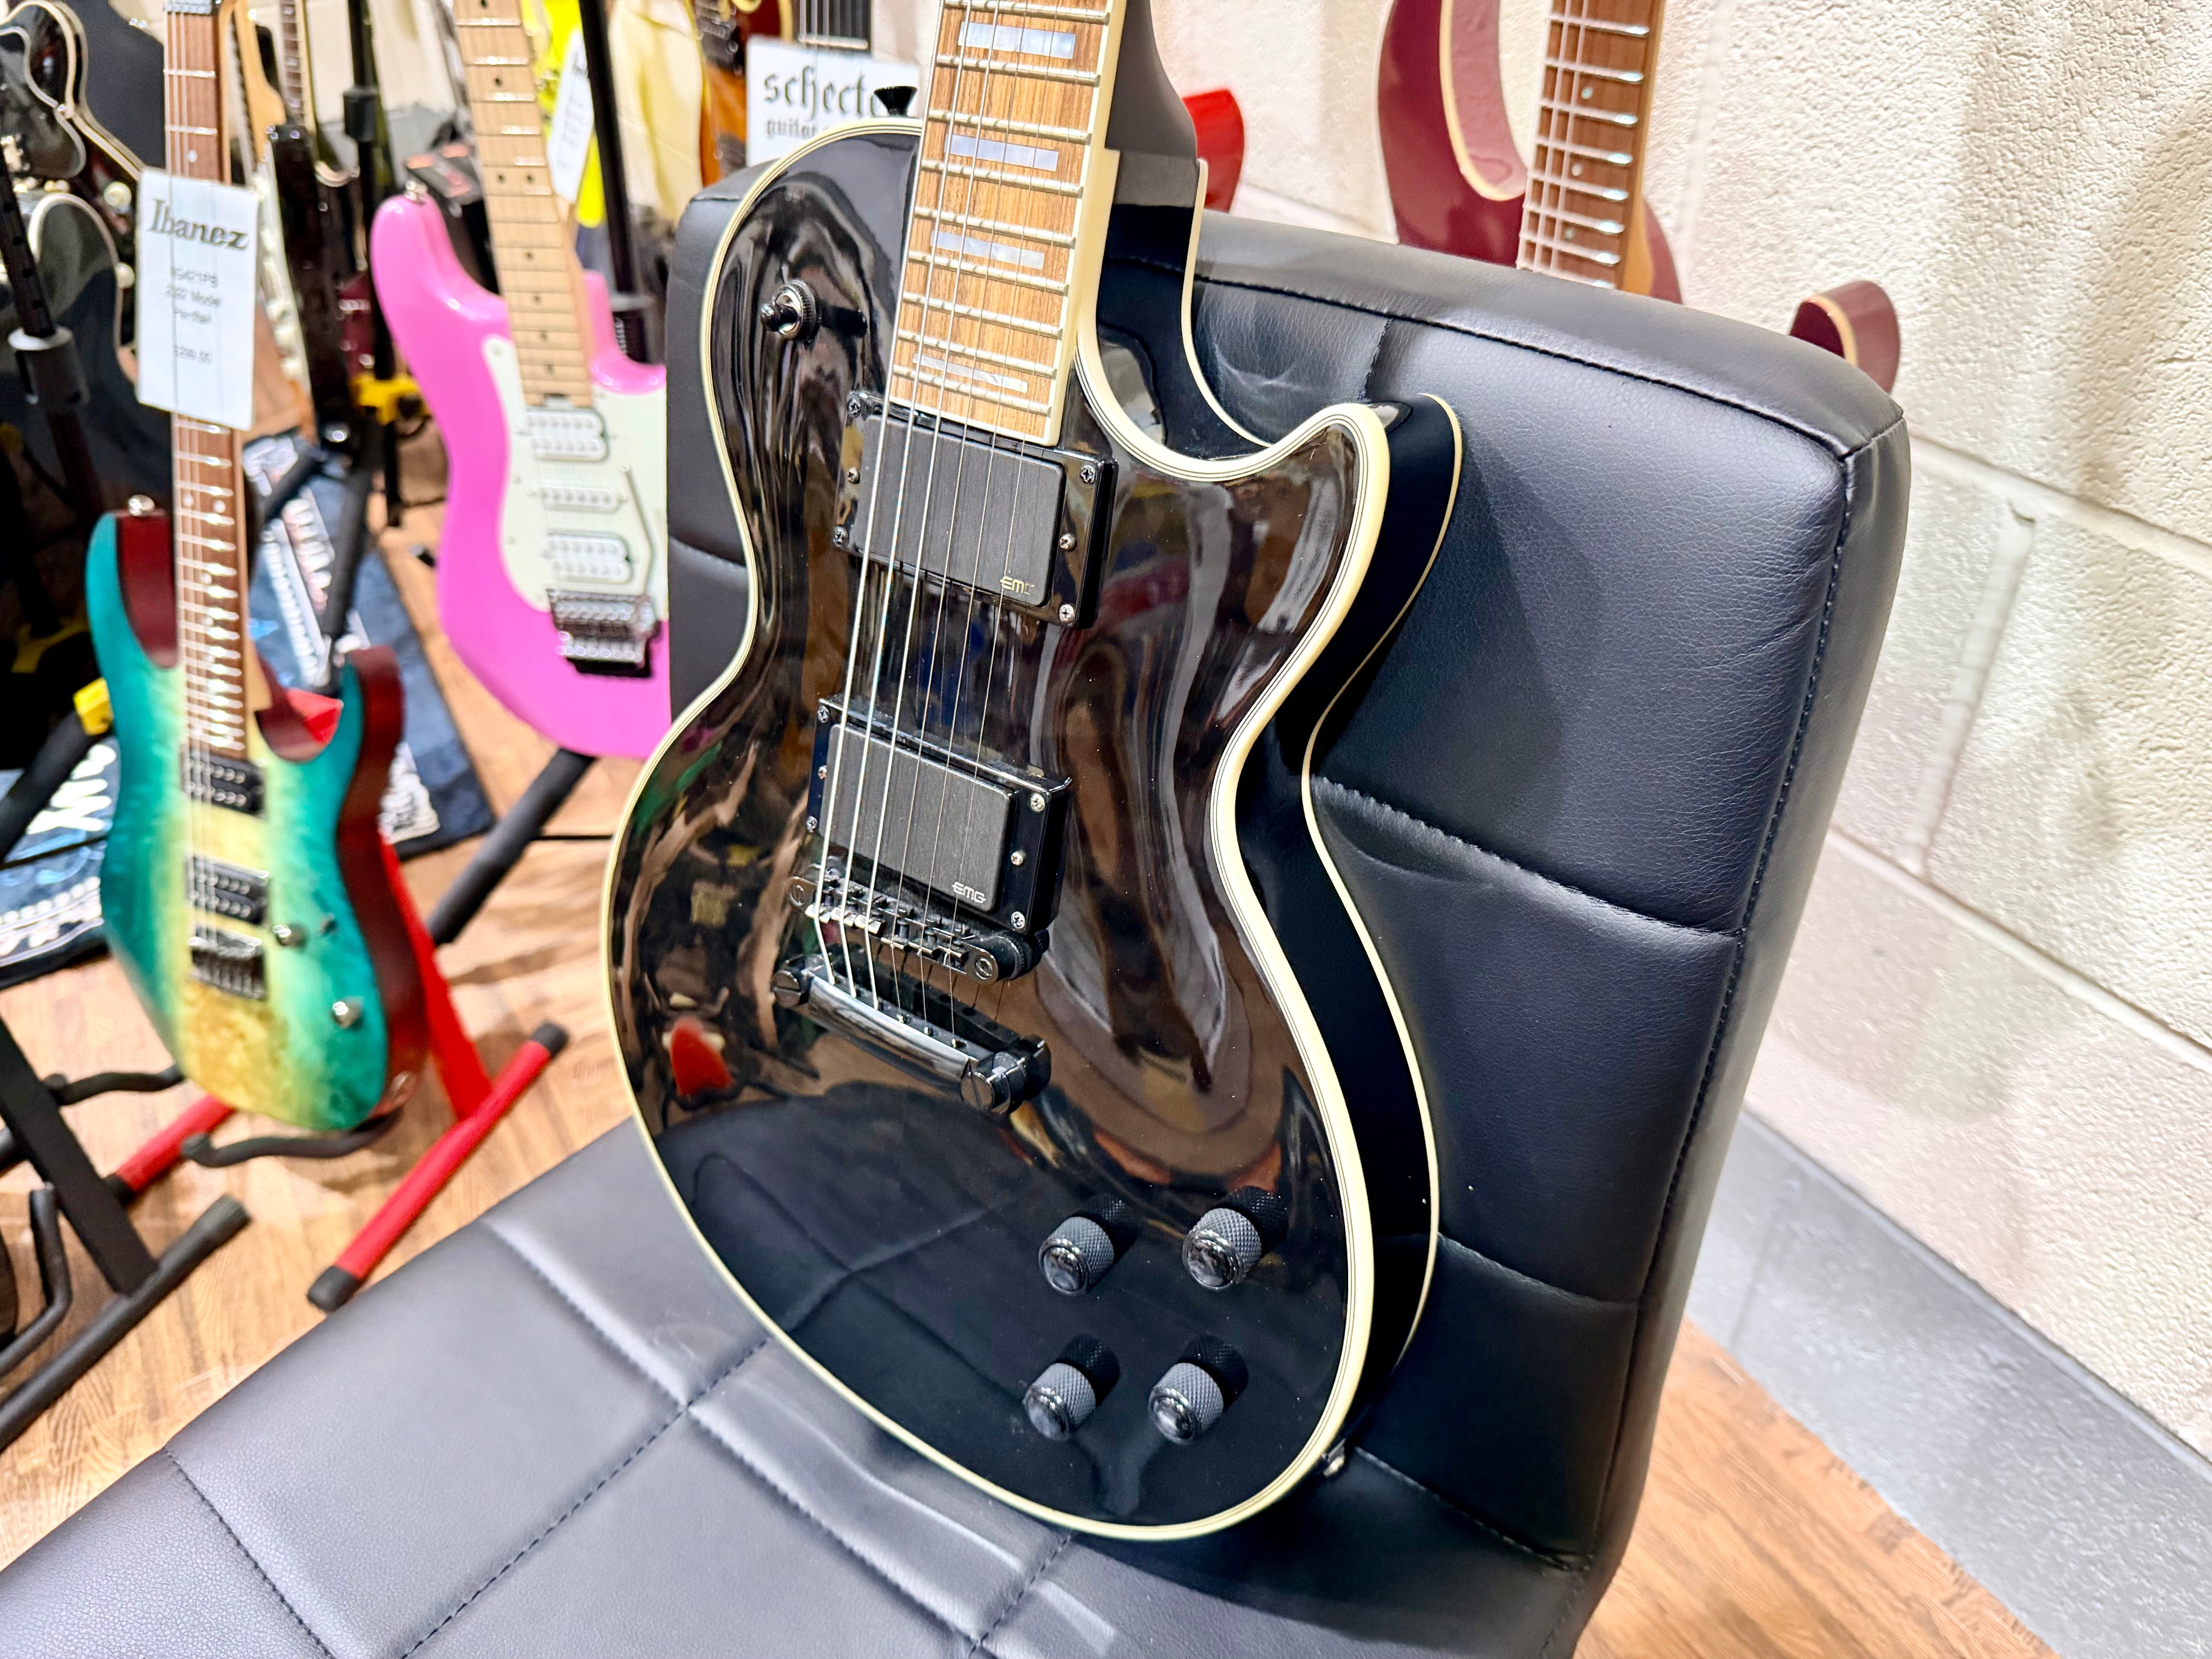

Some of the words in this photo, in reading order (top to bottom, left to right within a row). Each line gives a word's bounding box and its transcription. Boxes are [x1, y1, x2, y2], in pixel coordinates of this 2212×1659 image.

[764, 65, 887, 119] schecte
[147, 198, 247, 250] Ibanez
[952, 881, 986, 903] EMG
